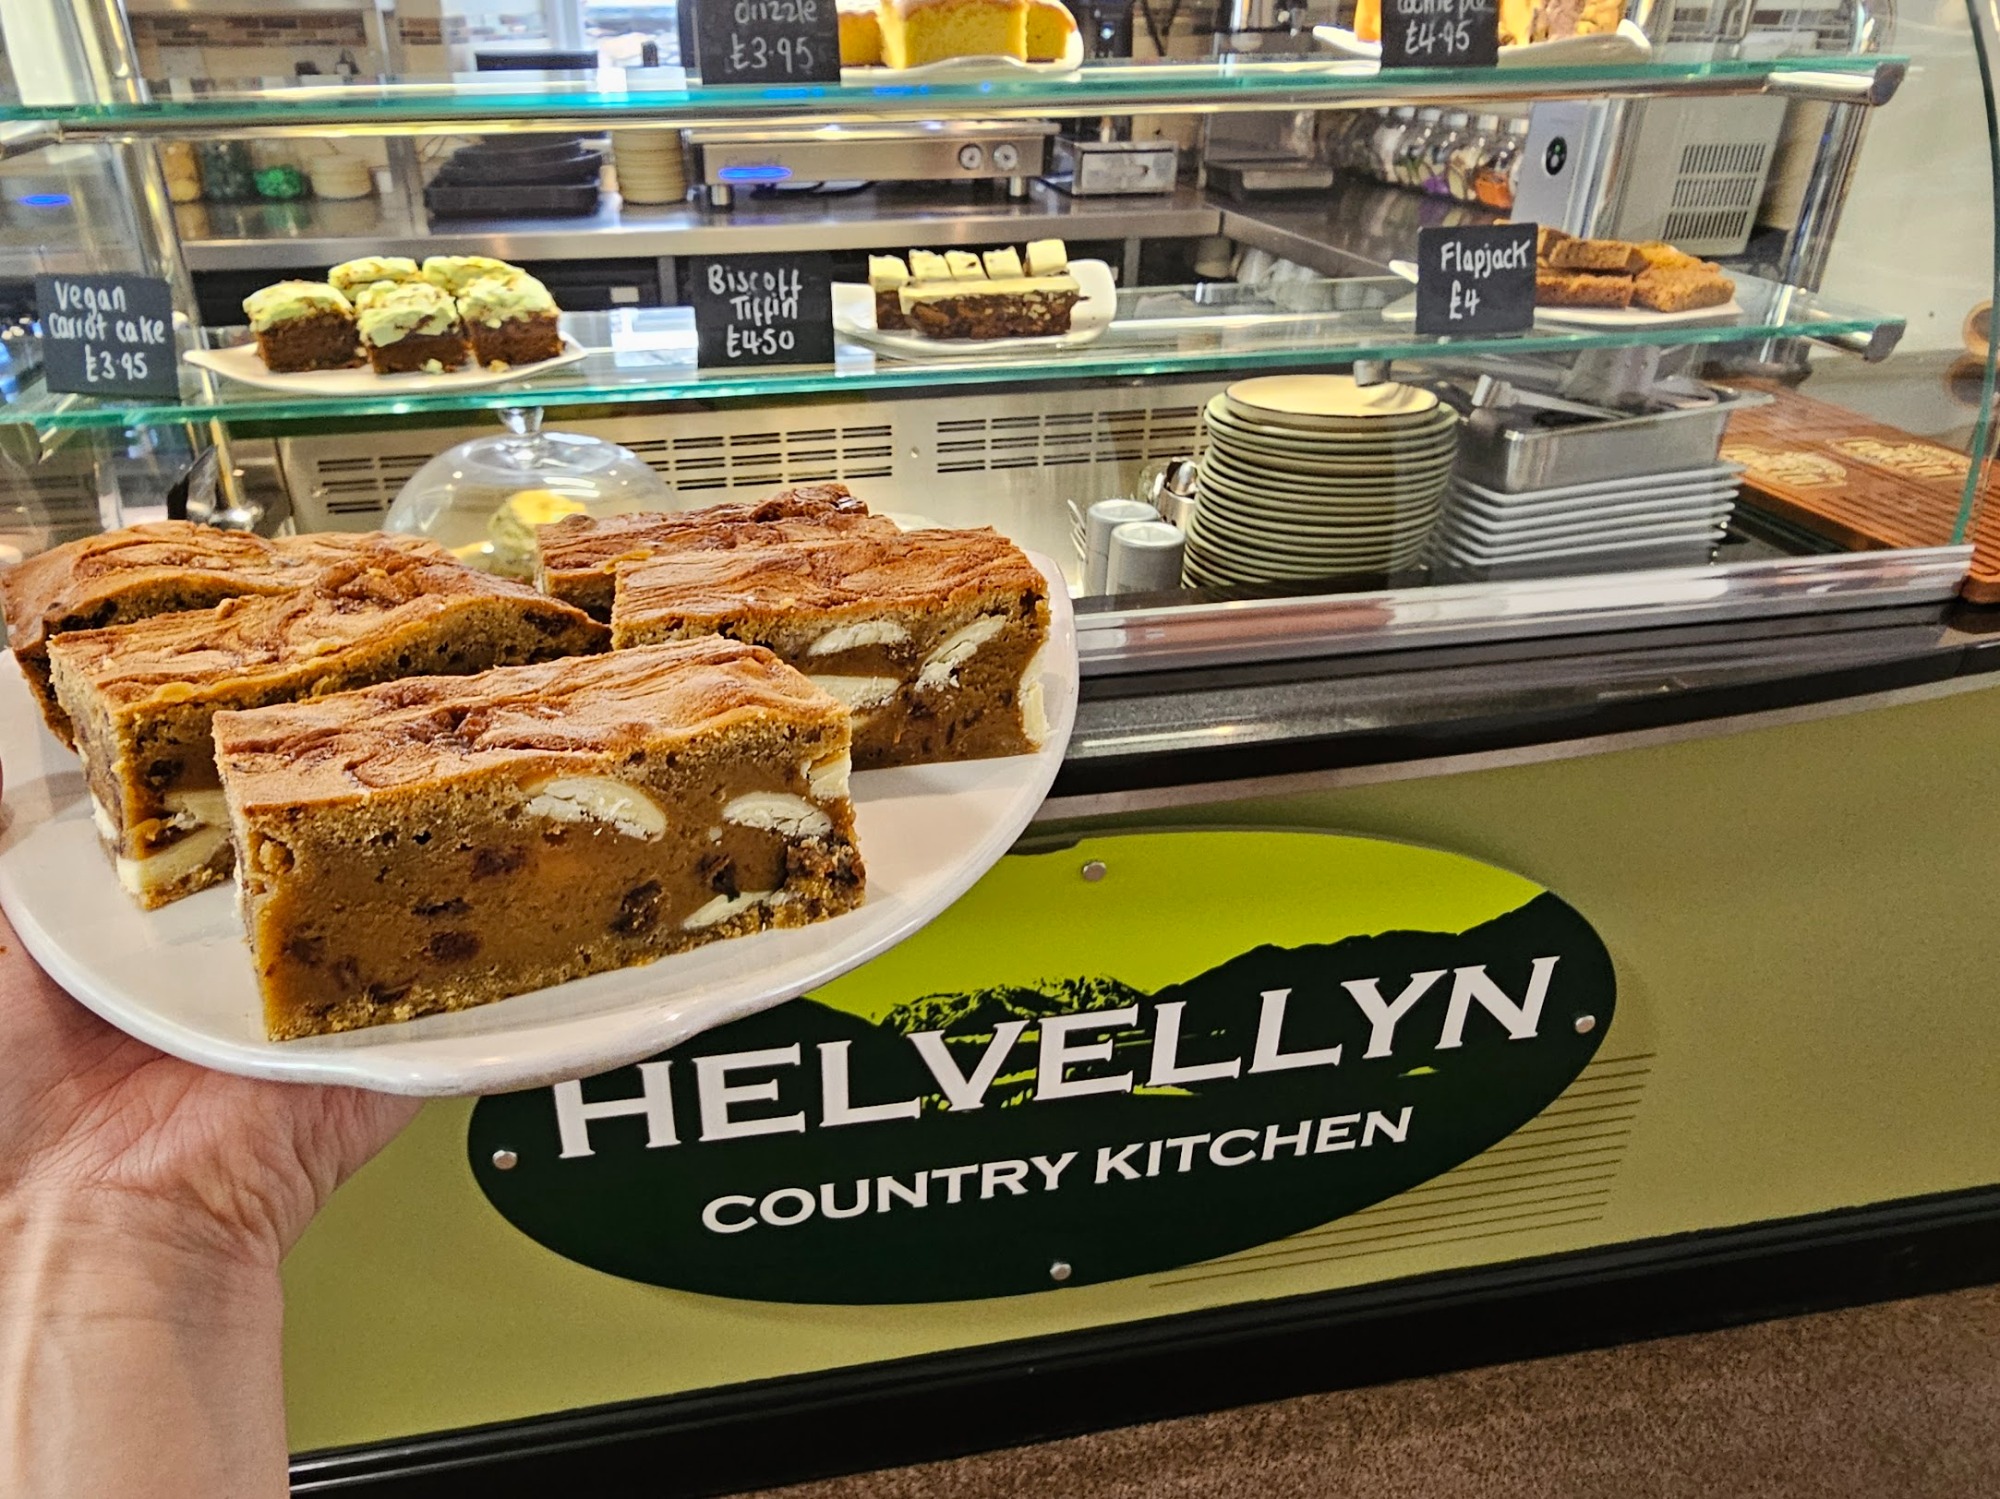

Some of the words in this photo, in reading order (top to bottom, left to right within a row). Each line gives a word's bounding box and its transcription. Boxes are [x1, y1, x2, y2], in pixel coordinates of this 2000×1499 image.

[54, 280, 127, 319] Vegan
[707, 264, 803, 301] Biscoff
[1449, 280, 1481, 320] £4
[729, 291, 798, 327] Tiffin
[115, 315, 166, 344] cake
[552, 956, 1561, 1159] HELVELLYN
[701, 1151, 1078, 1234] COUNTRY
[1094, 1106, 1414, 1188] KITCHEN
